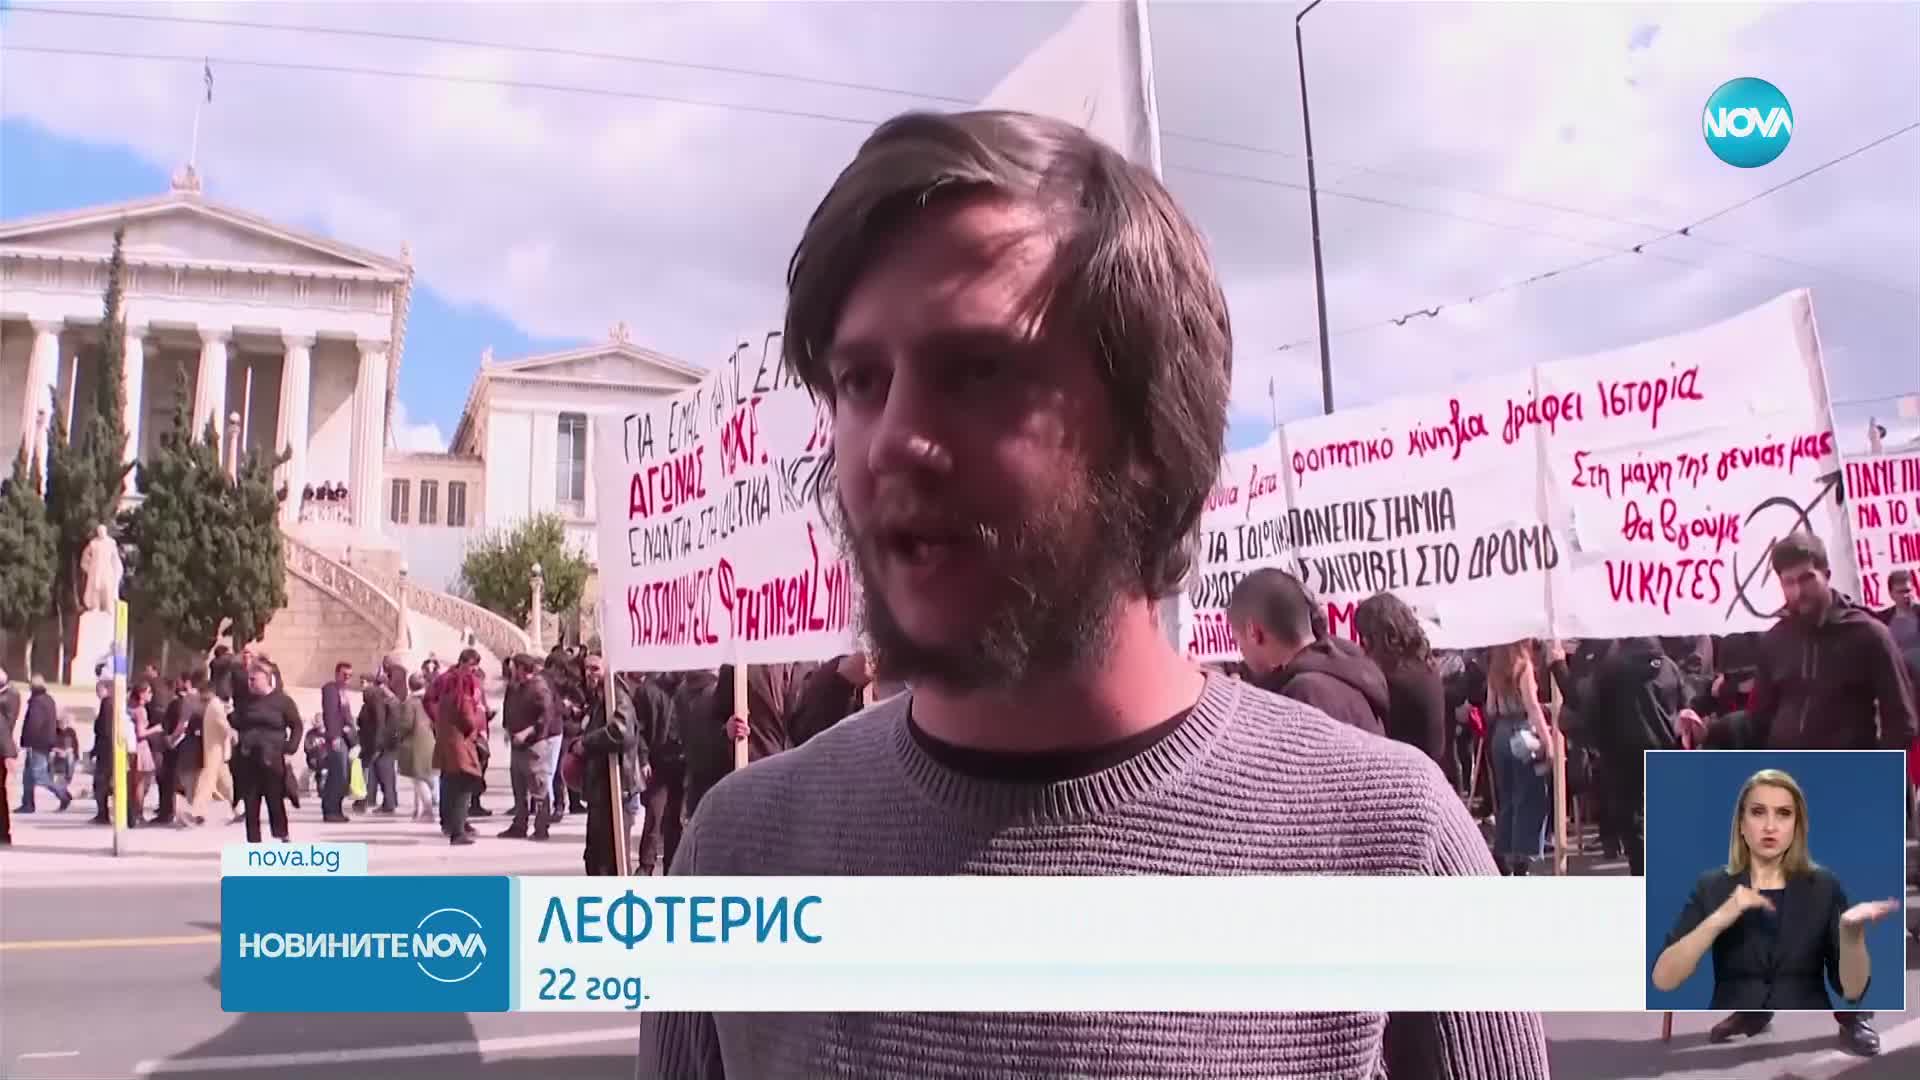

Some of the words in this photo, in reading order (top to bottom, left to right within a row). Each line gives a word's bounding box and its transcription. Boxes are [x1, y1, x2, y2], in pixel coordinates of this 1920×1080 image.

[1789, 431, 1833, 475] μας
[1288, 487, 1457, 550] ΠΑΝΕΠΙΣΤΗΜΙΑ
[1415, 542, 1460, 587] ΣΤΟ
